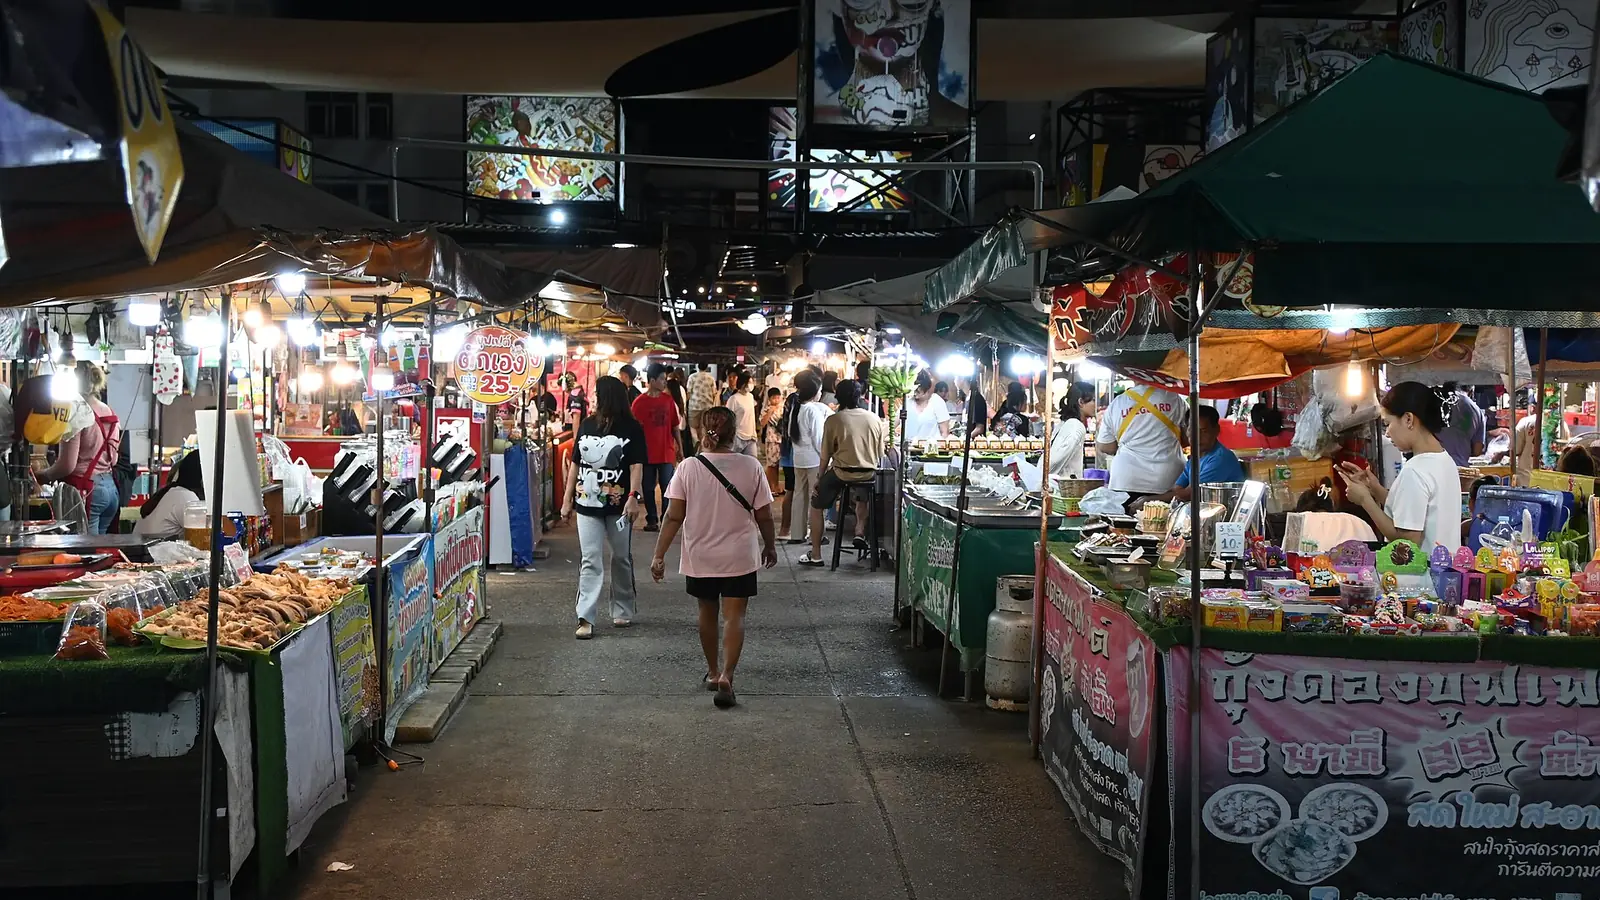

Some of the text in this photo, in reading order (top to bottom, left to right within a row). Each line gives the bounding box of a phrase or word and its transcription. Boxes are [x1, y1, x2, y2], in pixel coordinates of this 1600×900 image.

[458, 344, 526, 374] ตักเอง
[1281, 729, 1388, 778] นาที
[1418, 727, 1499, 783] 99
[1407, 790, 1600, 831] สด ใหม่ สะอา
